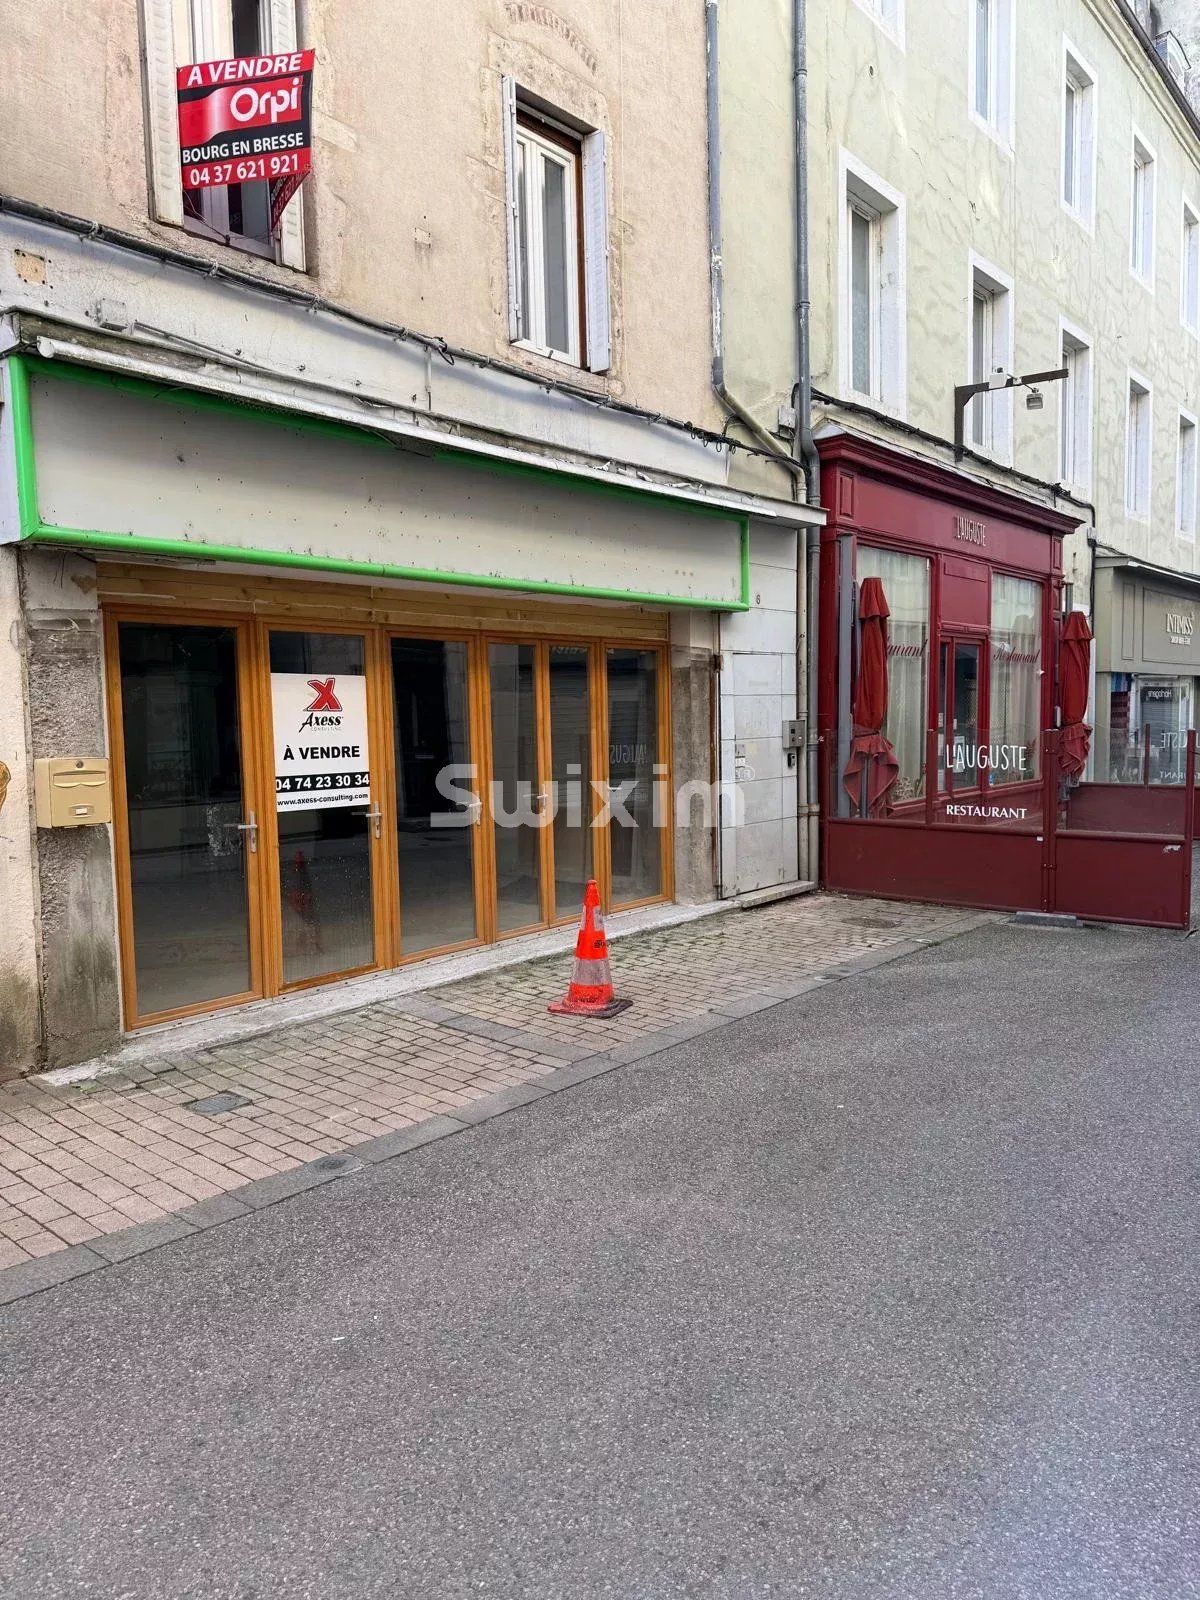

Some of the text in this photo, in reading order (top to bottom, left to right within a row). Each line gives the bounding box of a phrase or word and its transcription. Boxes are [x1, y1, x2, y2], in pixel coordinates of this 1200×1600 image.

[187, 53, 303, 86] A VENDRE
[230, 77, 300, 123] Orpi
[182, 132, 304, 164] BOURG EN BRESSE
[190, 153, 299, 186] 04 37 621 921
[298, 712, 342, 733] Axess
[283, 744, 361, 761] À VENDRE
[946, 743, 1027, 771] L'AUGUSTE
[275, 773, 370, 791] 04 74 23 30 34
[277, 792, 369, 806] www.axess-consulting.com
[946, 804, 1028, 819] RESTAURANT
